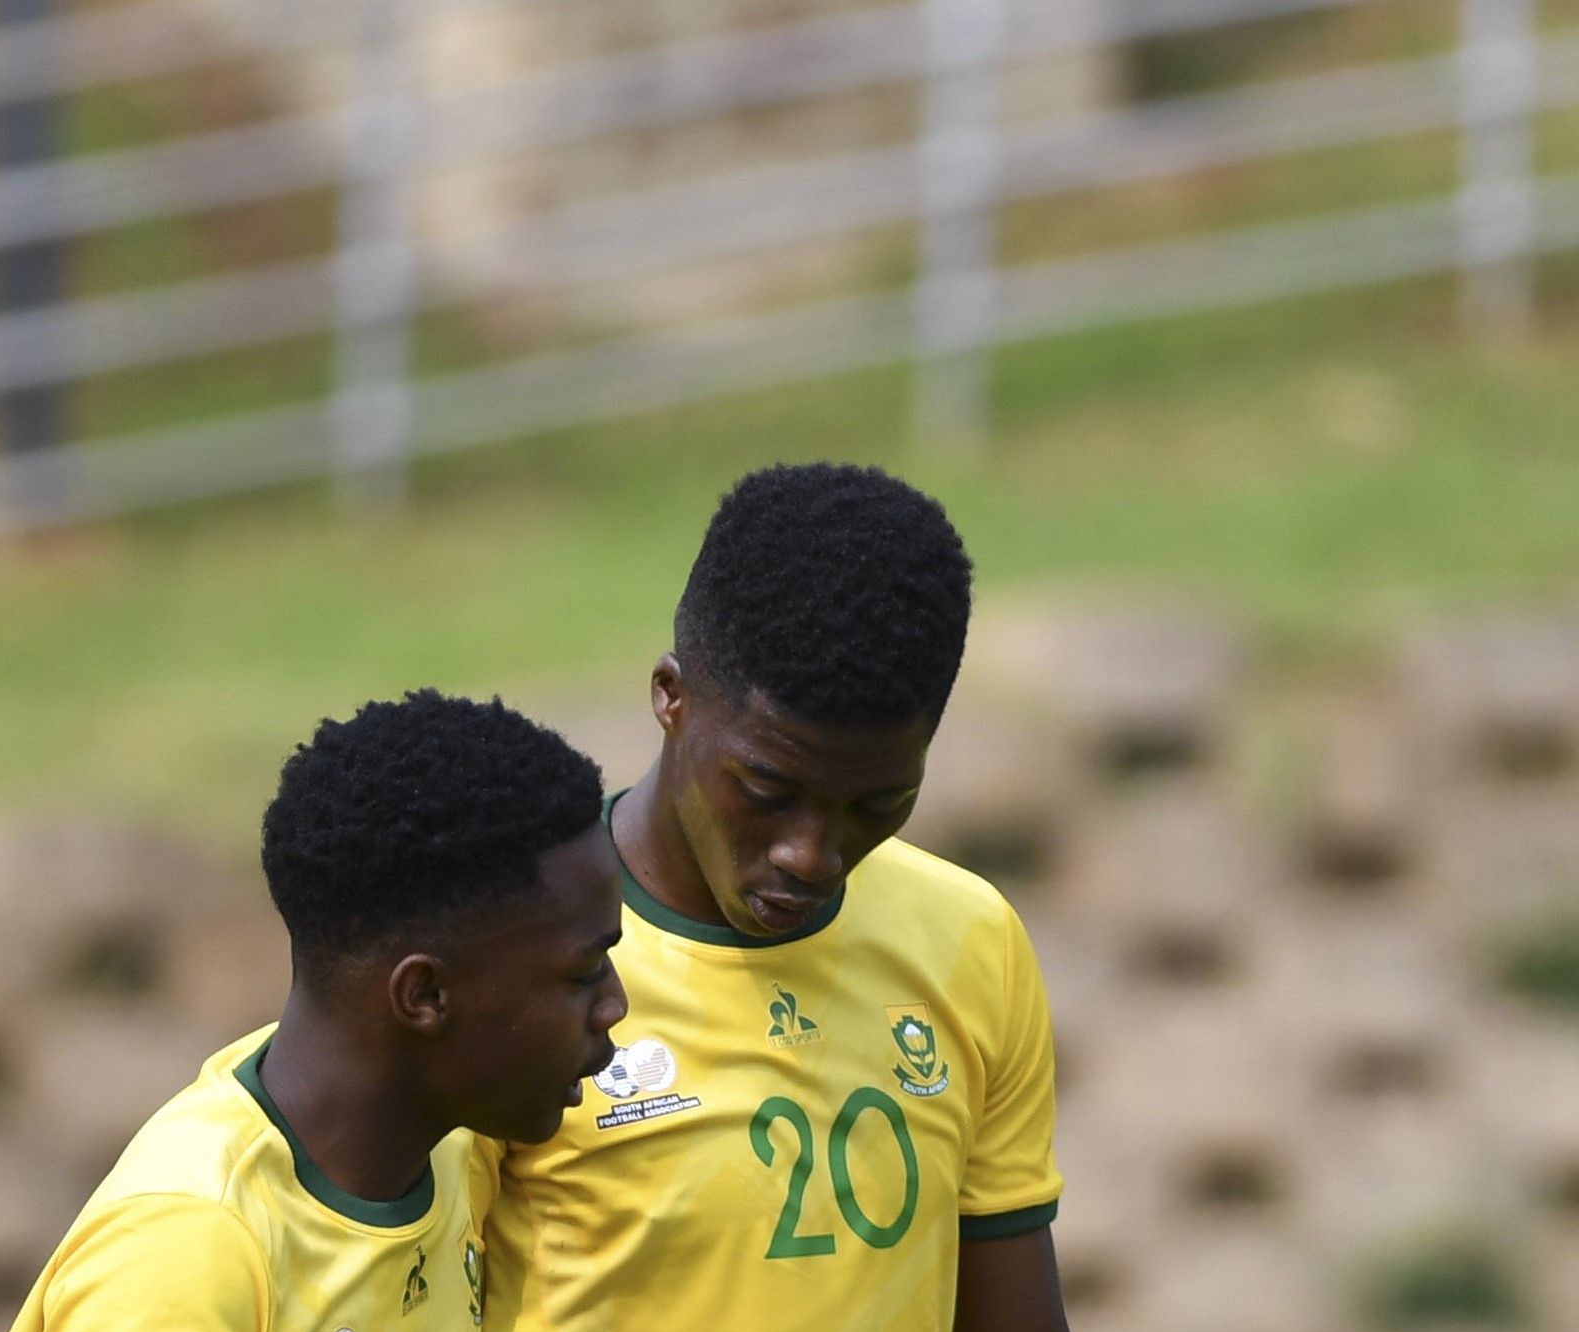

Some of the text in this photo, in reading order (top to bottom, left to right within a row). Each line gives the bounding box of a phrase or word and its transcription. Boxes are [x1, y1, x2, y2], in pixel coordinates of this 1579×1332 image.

[598, 1099, 700, 1127] FOOTBALL ASSOCIATION
[614, 1095, 679, 1114] SOUTH AFRICAN
[749, 1086, 919, 1260] 20
